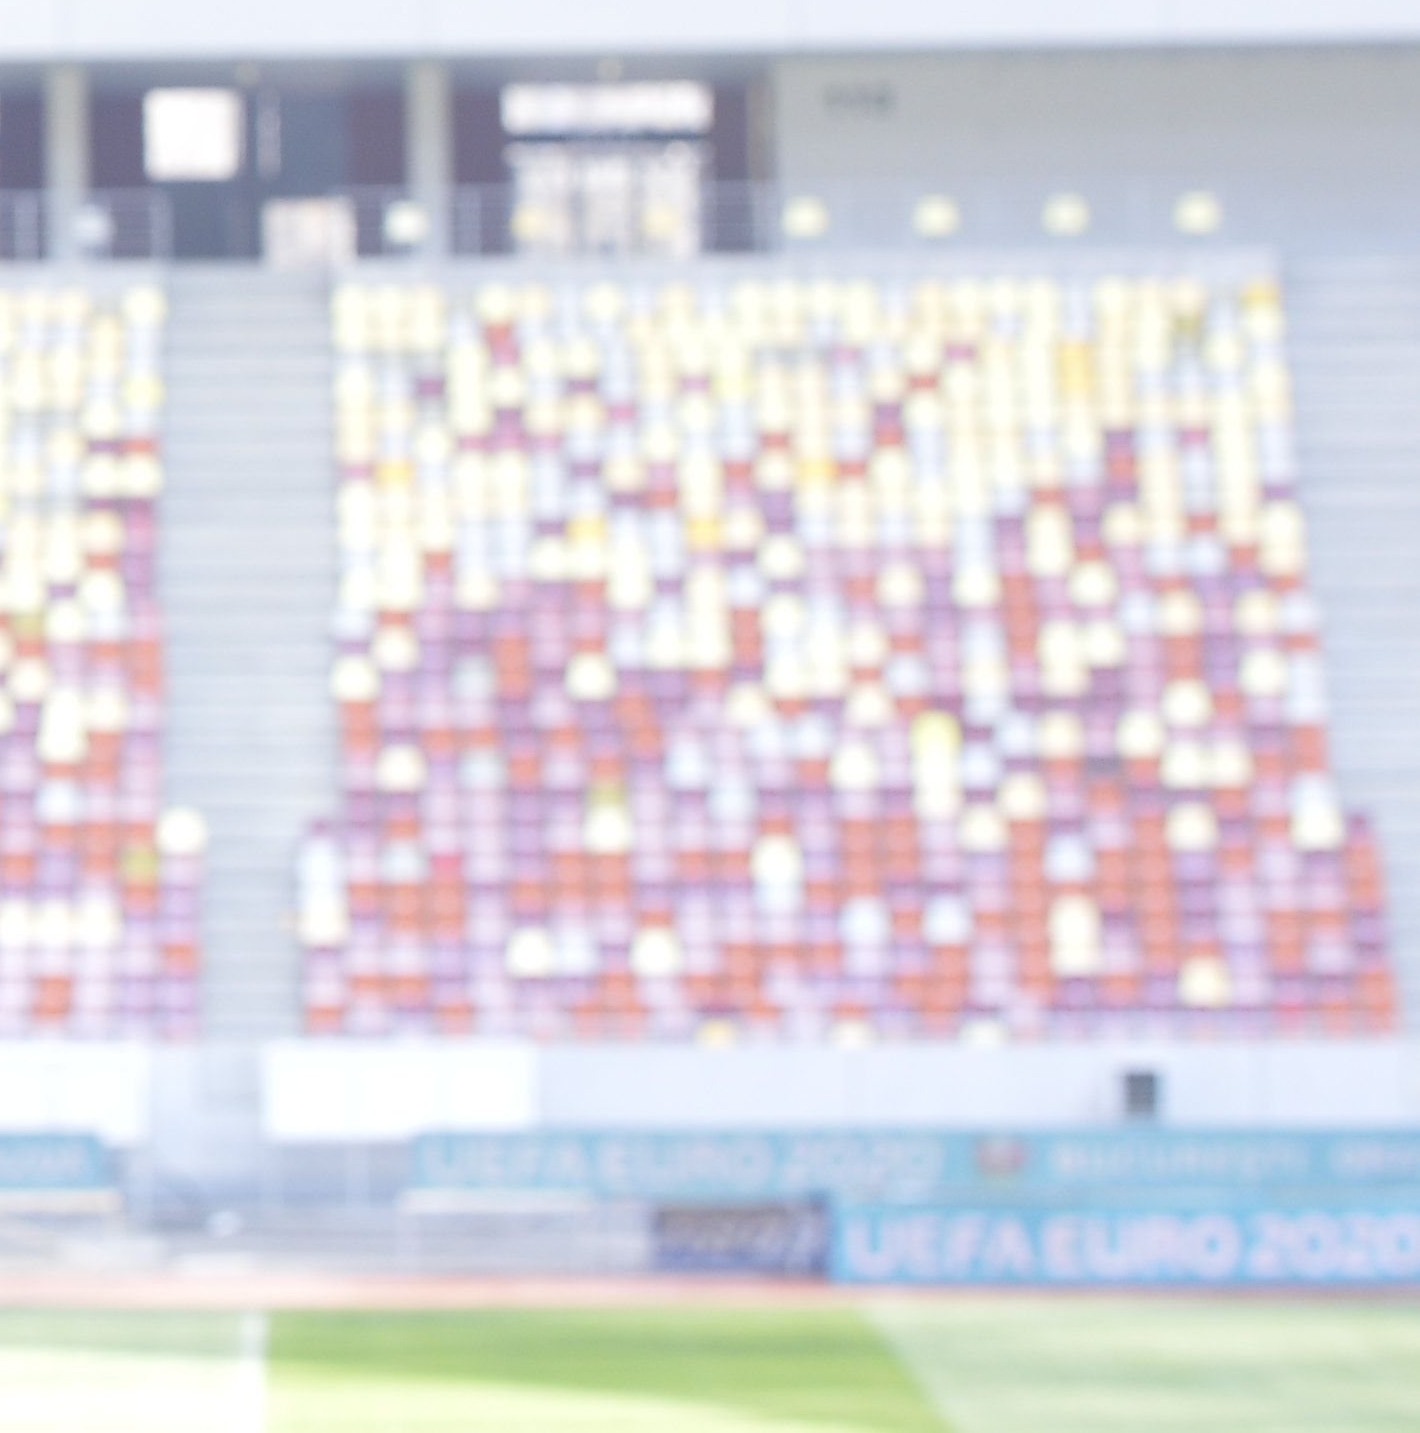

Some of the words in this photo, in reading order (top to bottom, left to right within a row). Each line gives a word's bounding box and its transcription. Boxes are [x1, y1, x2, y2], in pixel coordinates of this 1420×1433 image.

[842, 1212, 1038, 1278] UEFA
[1040, 1212, 1241, 1279] EURO
[1247, 1212, 1420, 1279] 2020
